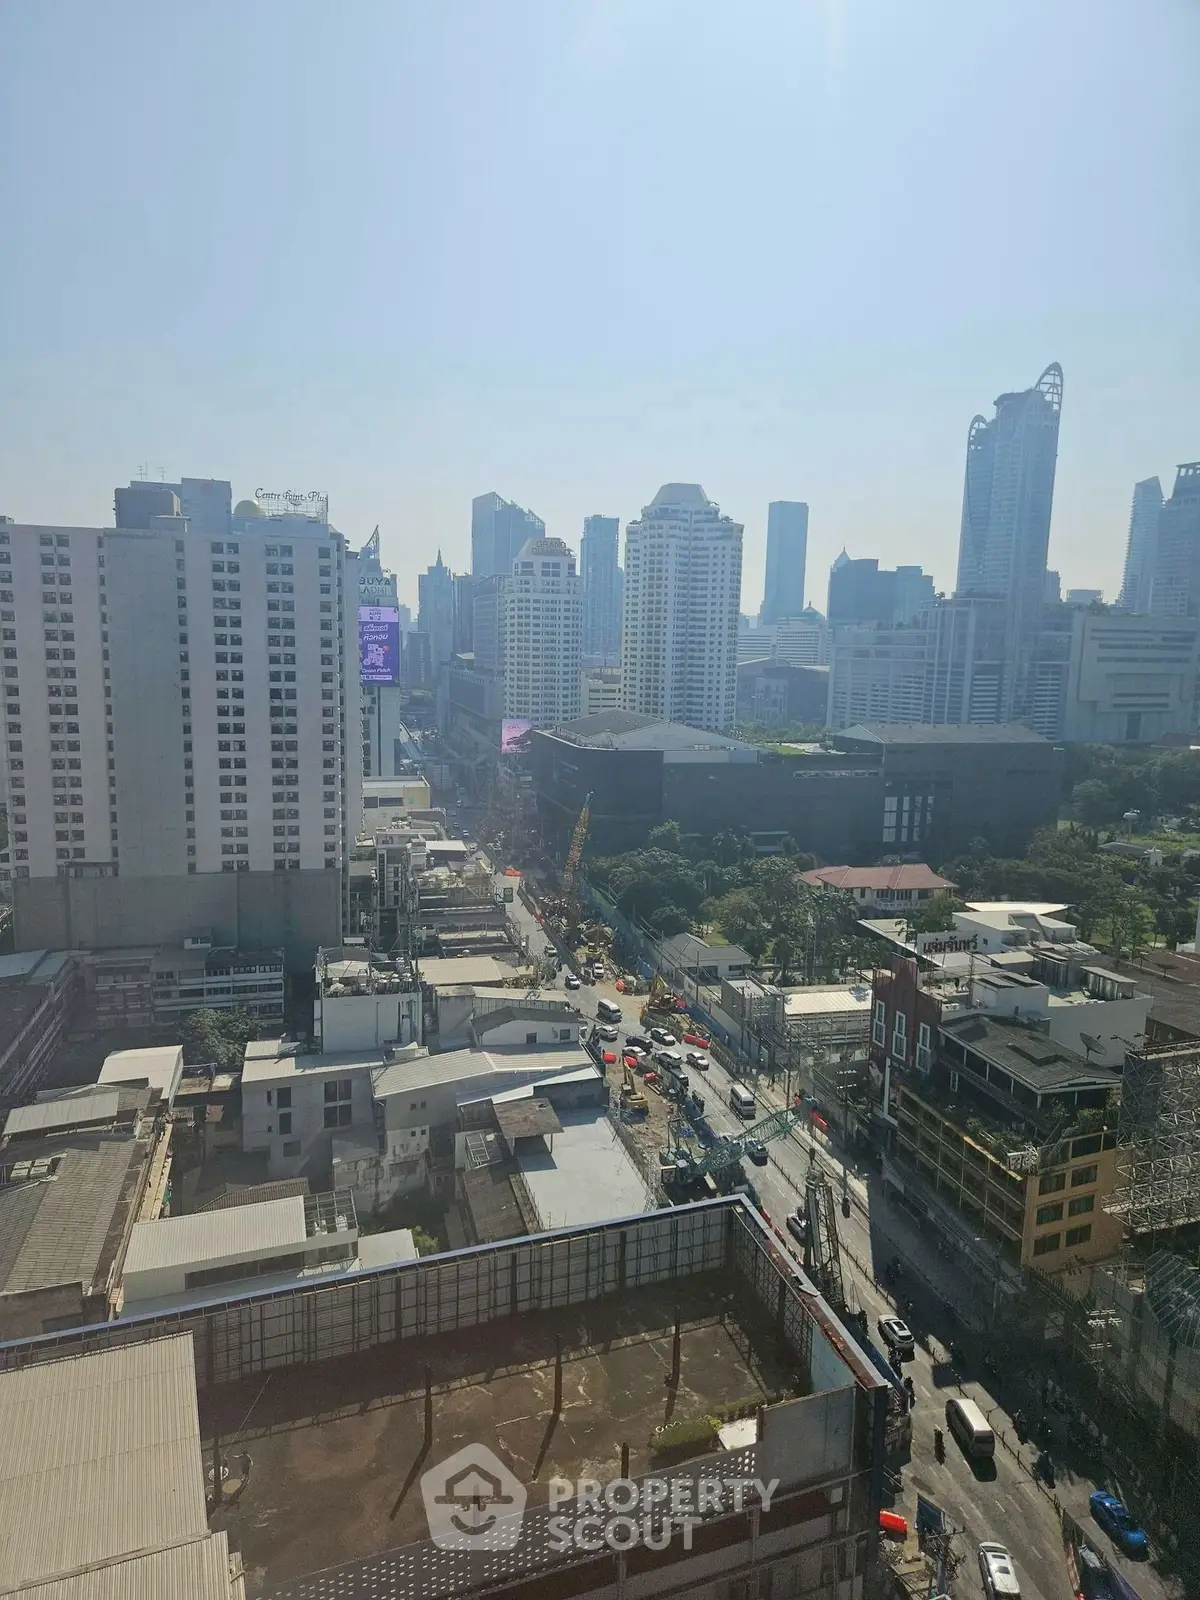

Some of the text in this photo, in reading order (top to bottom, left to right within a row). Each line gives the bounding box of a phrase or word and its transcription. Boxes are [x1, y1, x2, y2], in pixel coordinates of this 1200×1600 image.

[254, 487, 328, 502] Centre Point Plus
[537, 540, 567, 548] GRAND
